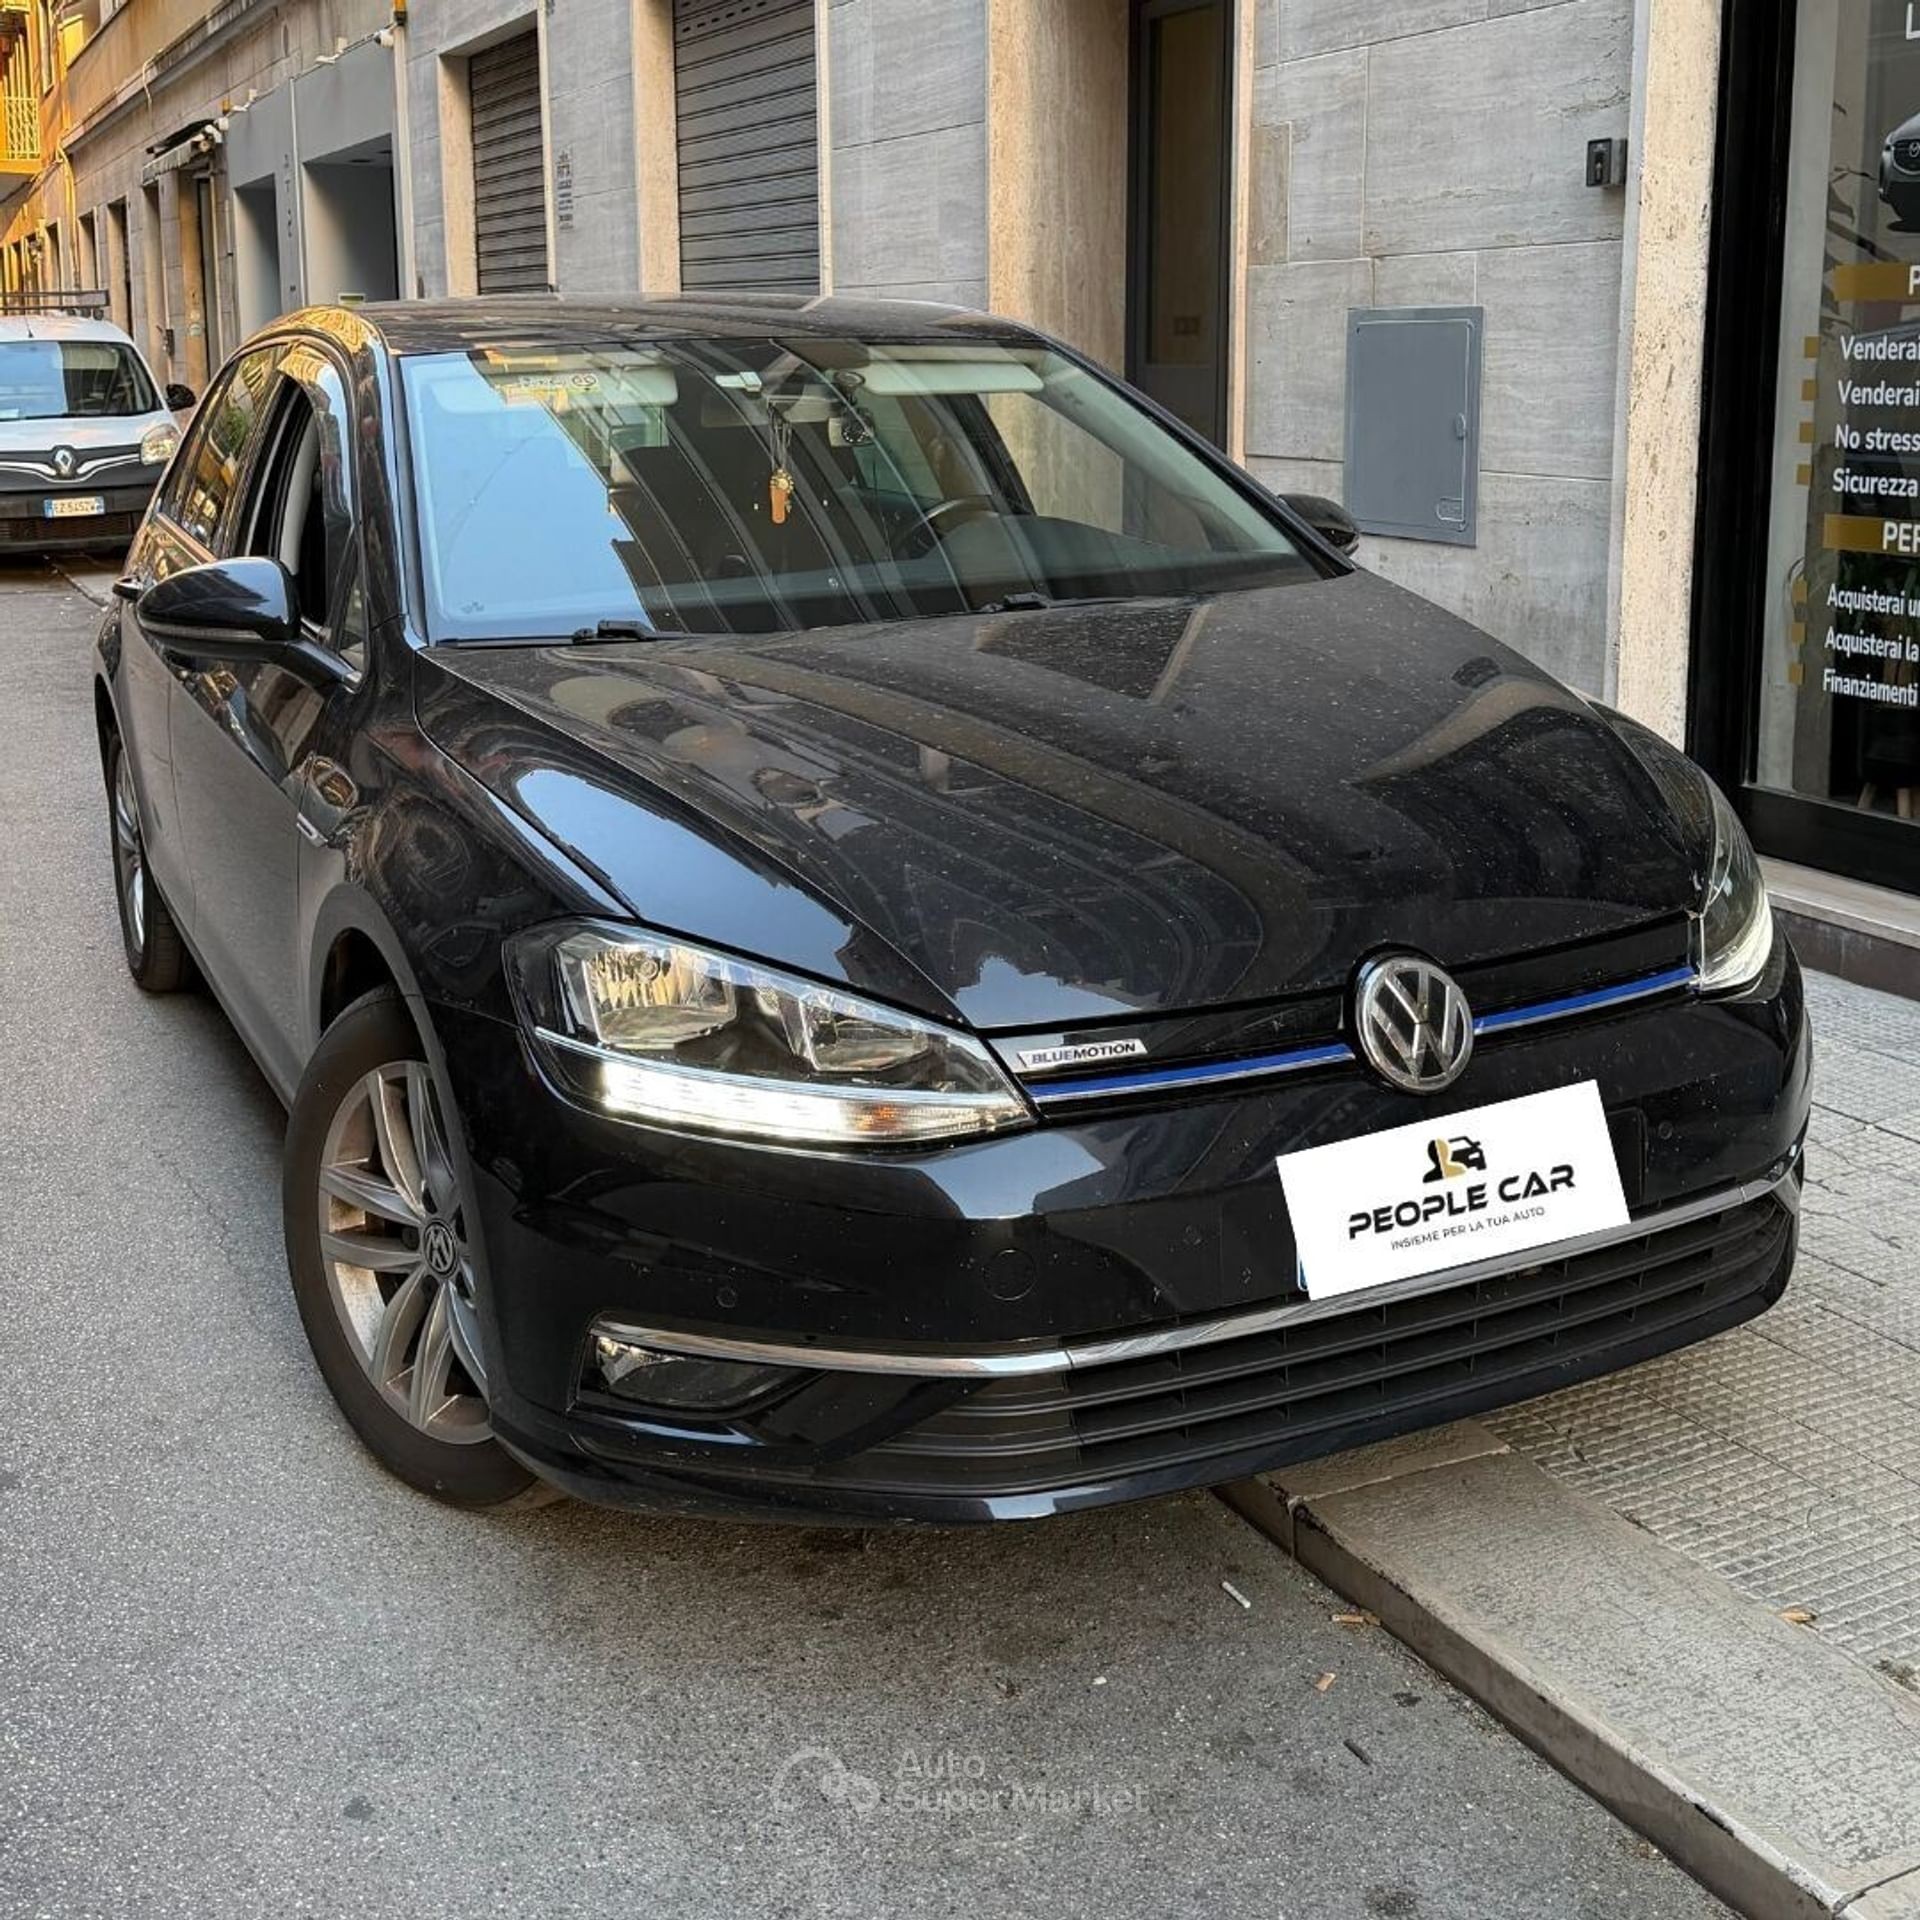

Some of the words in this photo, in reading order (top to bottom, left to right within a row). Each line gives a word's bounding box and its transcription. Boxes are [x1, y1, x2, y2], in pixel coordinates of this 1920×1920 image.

[1840, 335, 1920, 360] Venderai
[1838, 380, 1920, 406] Venderai
[1834, 424, 1860, 449] No
[1865, 427, 1920, 451] stress
[1832, 467, 1918, 497] Sicurezza
[1827, 583, 1905, 615] Acquisterai
[1824, 625, 1902, 659] Acquisterai
[1905, 635, 1919, 662] la
[1823, 668, 1918, 706] Finanziamenti
[1031, 1042, 1136, 1064] BLUEMOTION
